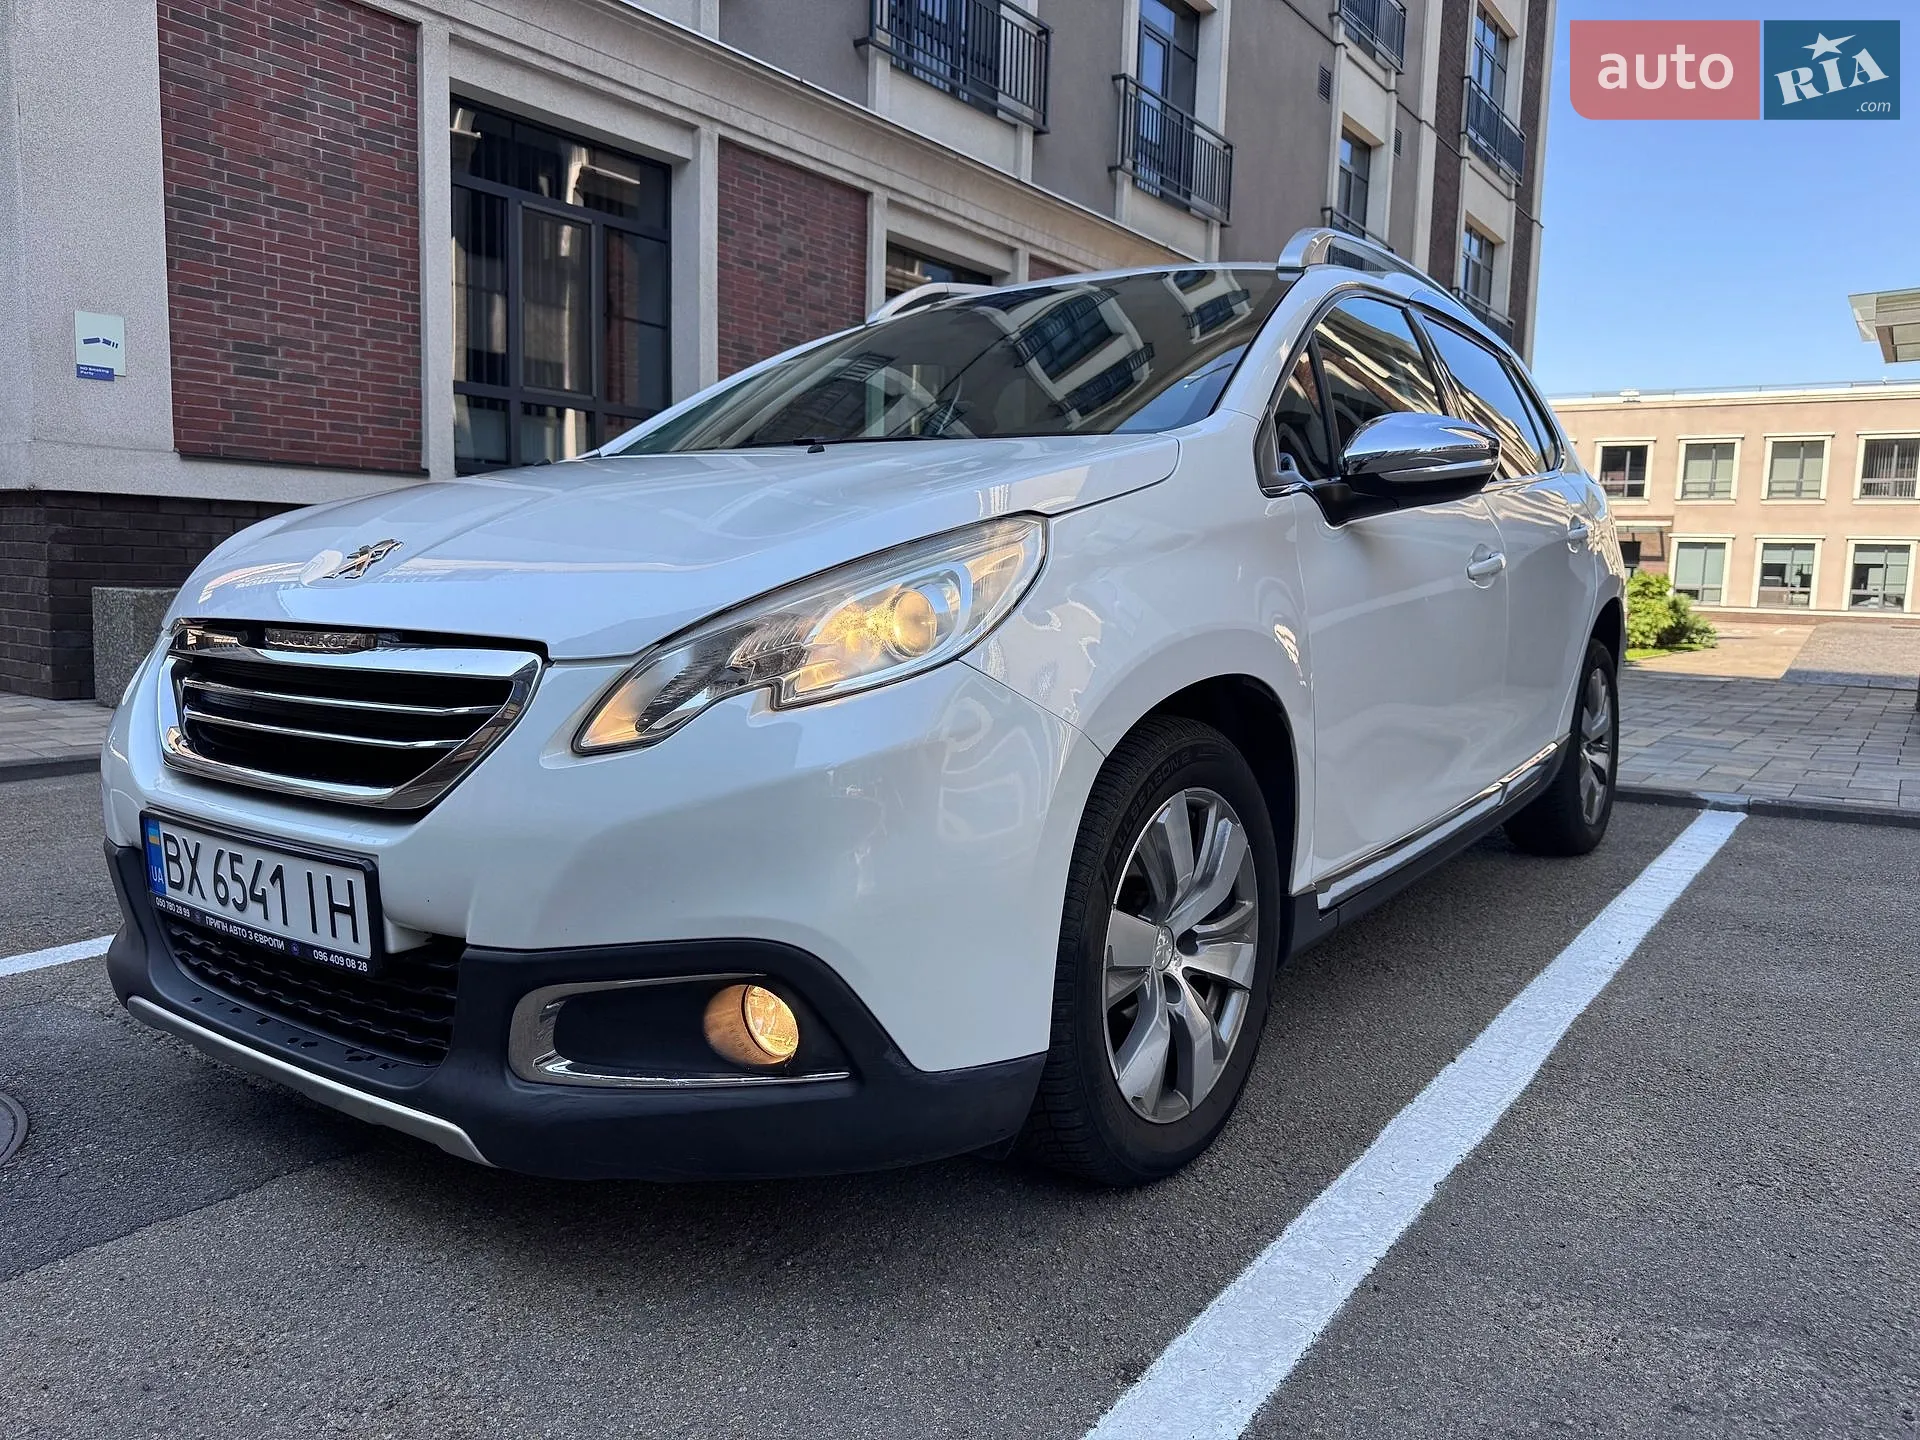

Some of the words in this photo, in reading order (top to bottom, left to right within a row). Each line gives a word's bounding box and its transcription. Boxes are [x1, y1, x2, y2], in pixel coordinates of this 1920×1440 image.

[151, 865, 164, 884] UA
[162, 831, 207, 900] BX
[213, 848, 289, 926] 6541
[306, 871, 360, 944] IH
[155, 896, 166, 908] 050
[229, 924, 248, 938] АВТО
[253, 932, 285, 950] ЄВРОПИ
[313, 949, 328, 962] 096
[330, 953, 345, 966] 409
[345, 957, 357, 969] 08
[357, 960, 368, 972] 28
